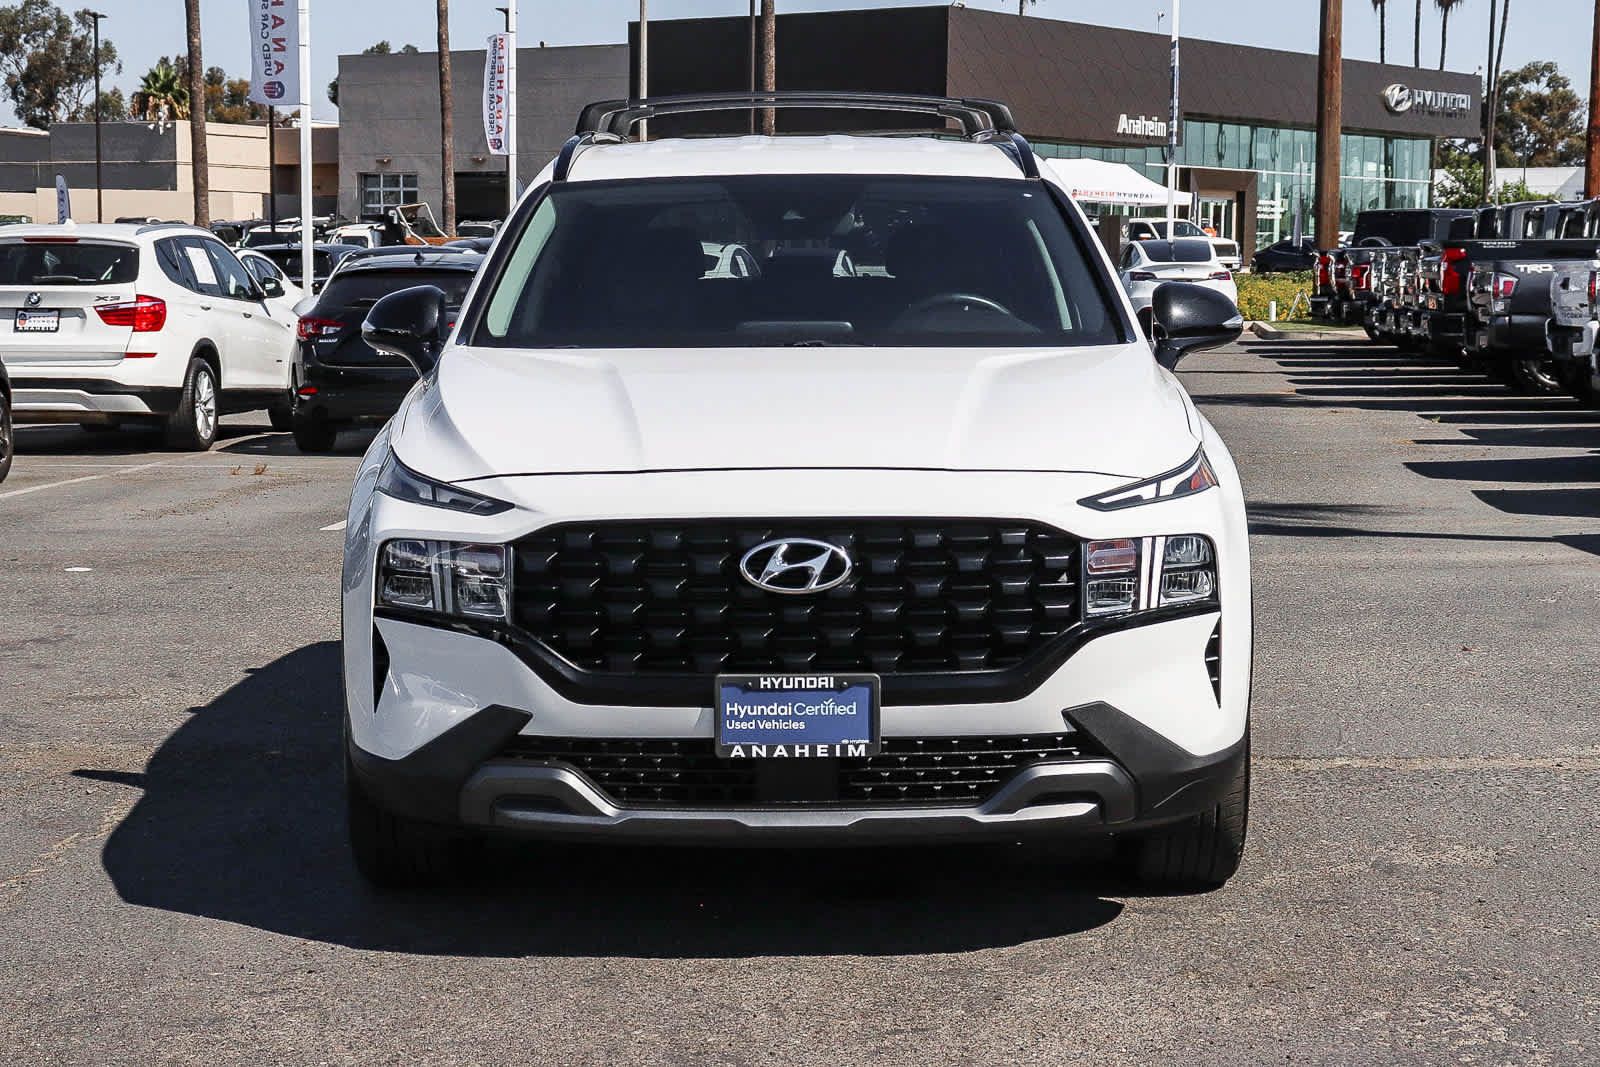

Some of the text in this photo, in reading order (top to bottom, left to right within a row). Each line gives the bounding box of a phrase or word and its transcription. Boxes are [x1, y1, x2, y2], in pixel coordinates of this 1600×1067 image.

[1413, 89, 1471, 111] HYUNDAI
[1117, 113, 1167, 137] Anaheim
[1117, 191, 1153, 199] HYUNDAI
[1515, 263, 1553, 274] TRD
[760, 676, 834, 689] HYUNDAI
[726, 698, 857, 718] Hyundai Certified
[726, 719, 805, 730] Used Vehicles
[730, 744, 866, 758] ANAHEIM
